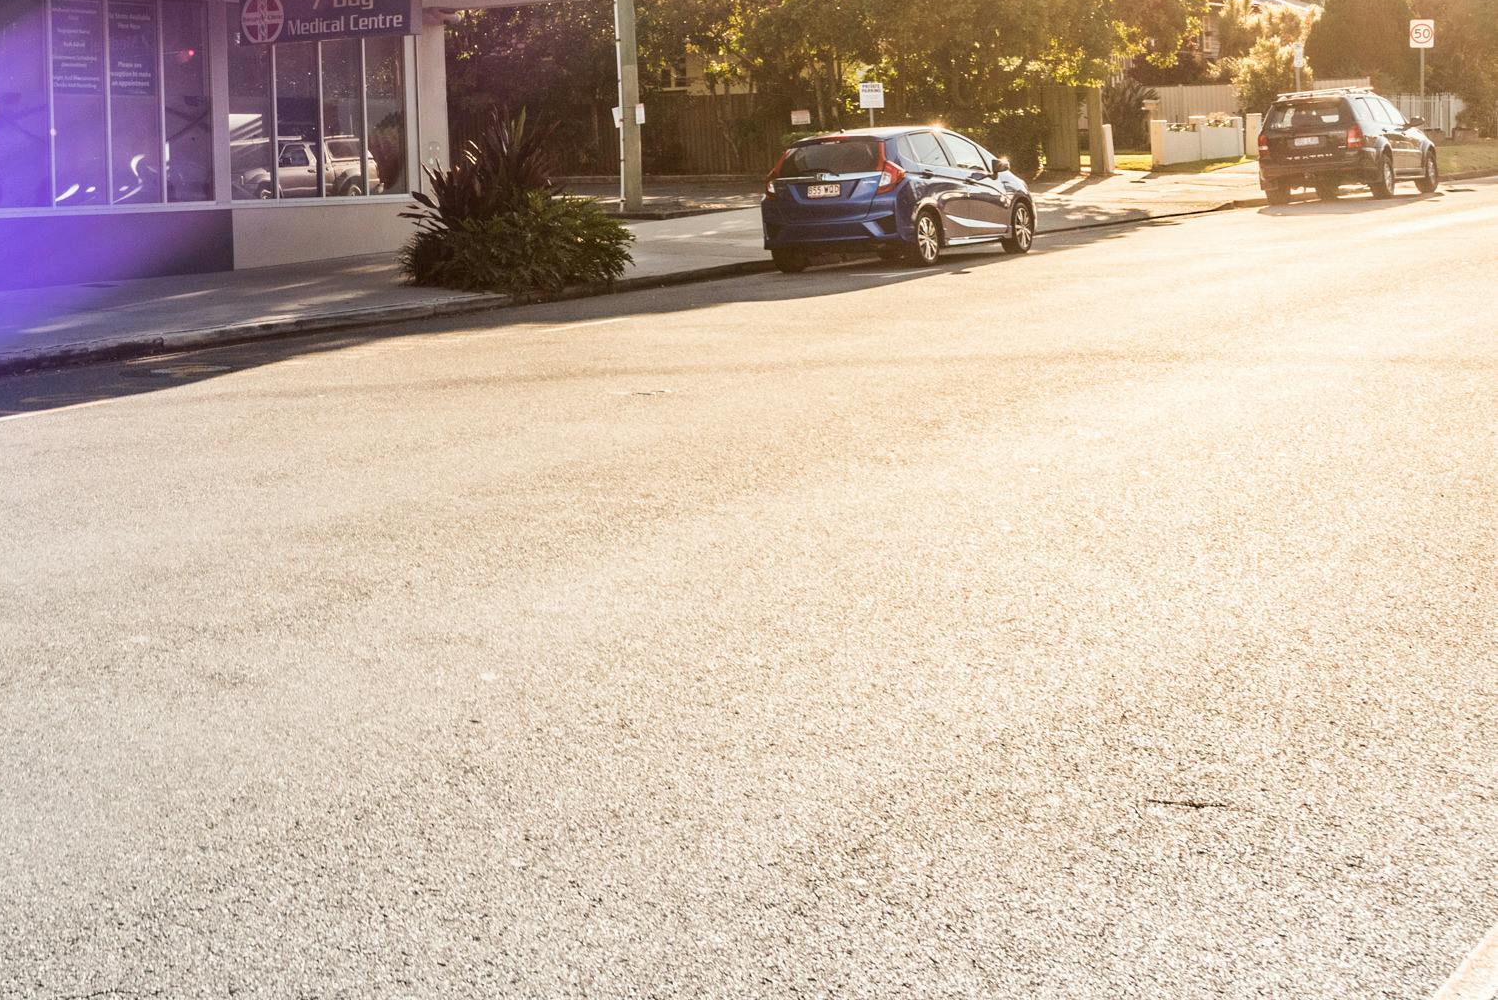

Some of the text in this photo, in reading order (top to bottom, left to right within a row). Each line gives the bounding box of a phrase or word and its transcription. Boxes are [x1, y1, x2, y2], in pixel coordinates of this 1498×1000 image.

[287, 14, 403, 36] Medical Centre
[1414, 28, 1431, 39] 50
